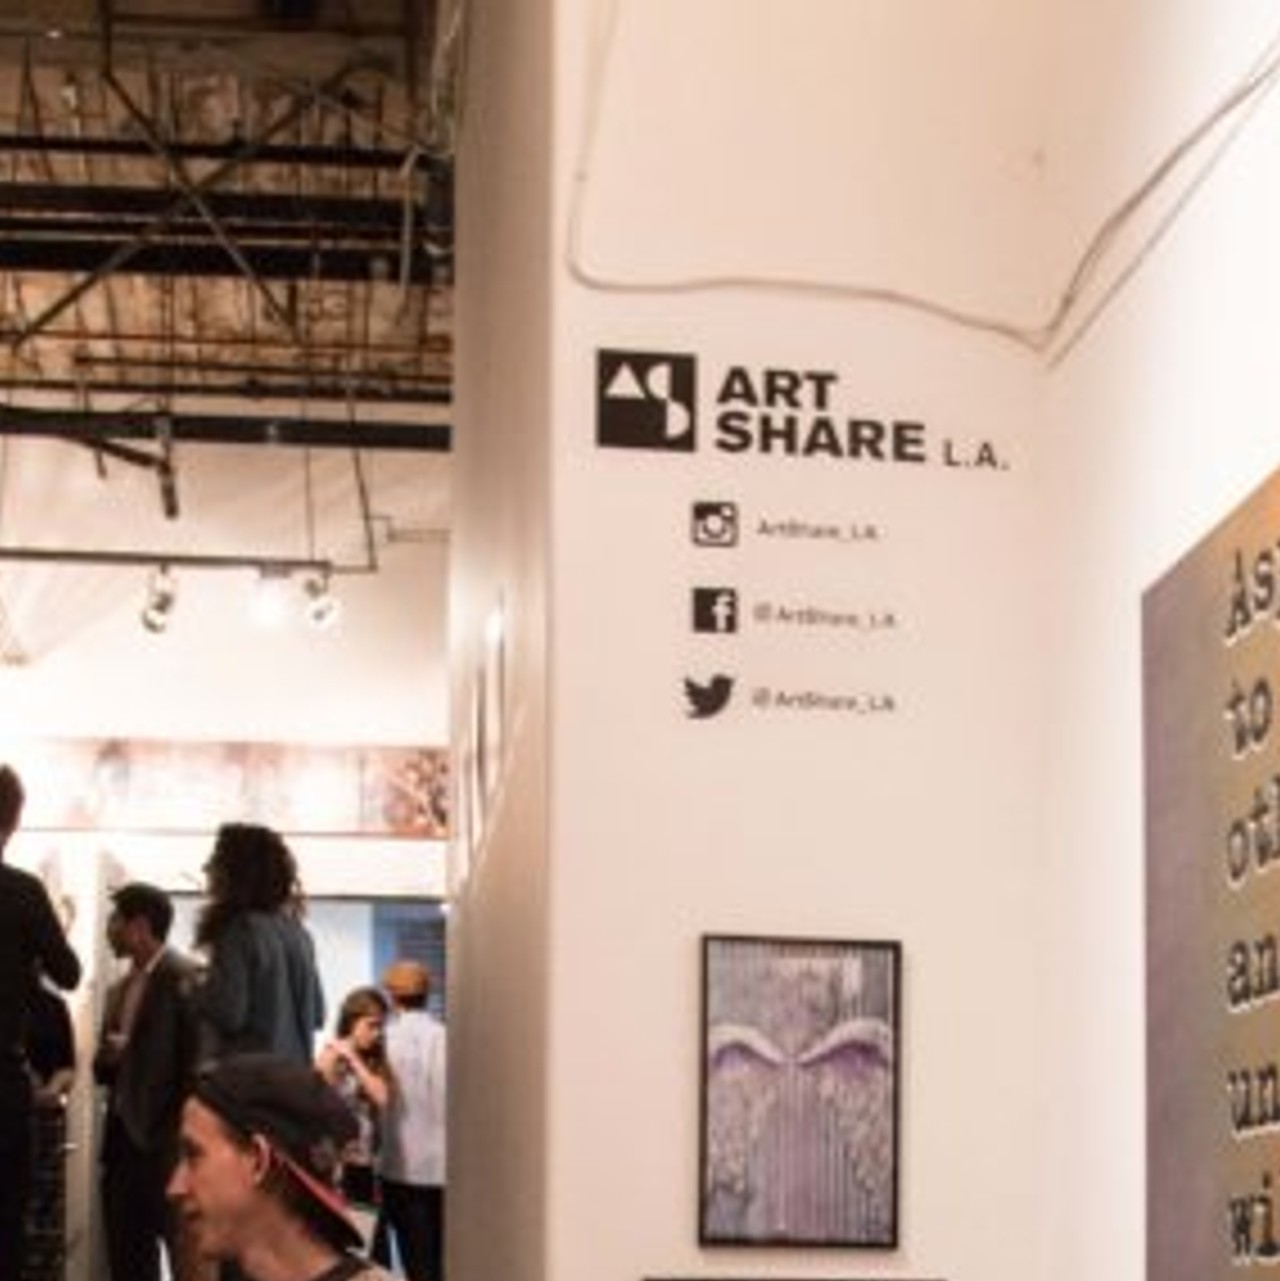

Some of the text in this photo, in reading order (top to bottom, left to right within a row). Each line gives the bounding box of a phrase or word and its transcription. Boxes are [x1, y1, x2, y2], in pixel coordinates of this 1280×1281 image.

[716, 366, 839, 412] ART
[714, 410, 1010, 470] SHARE L.A.
[1226, 677, 1273, 755] to
